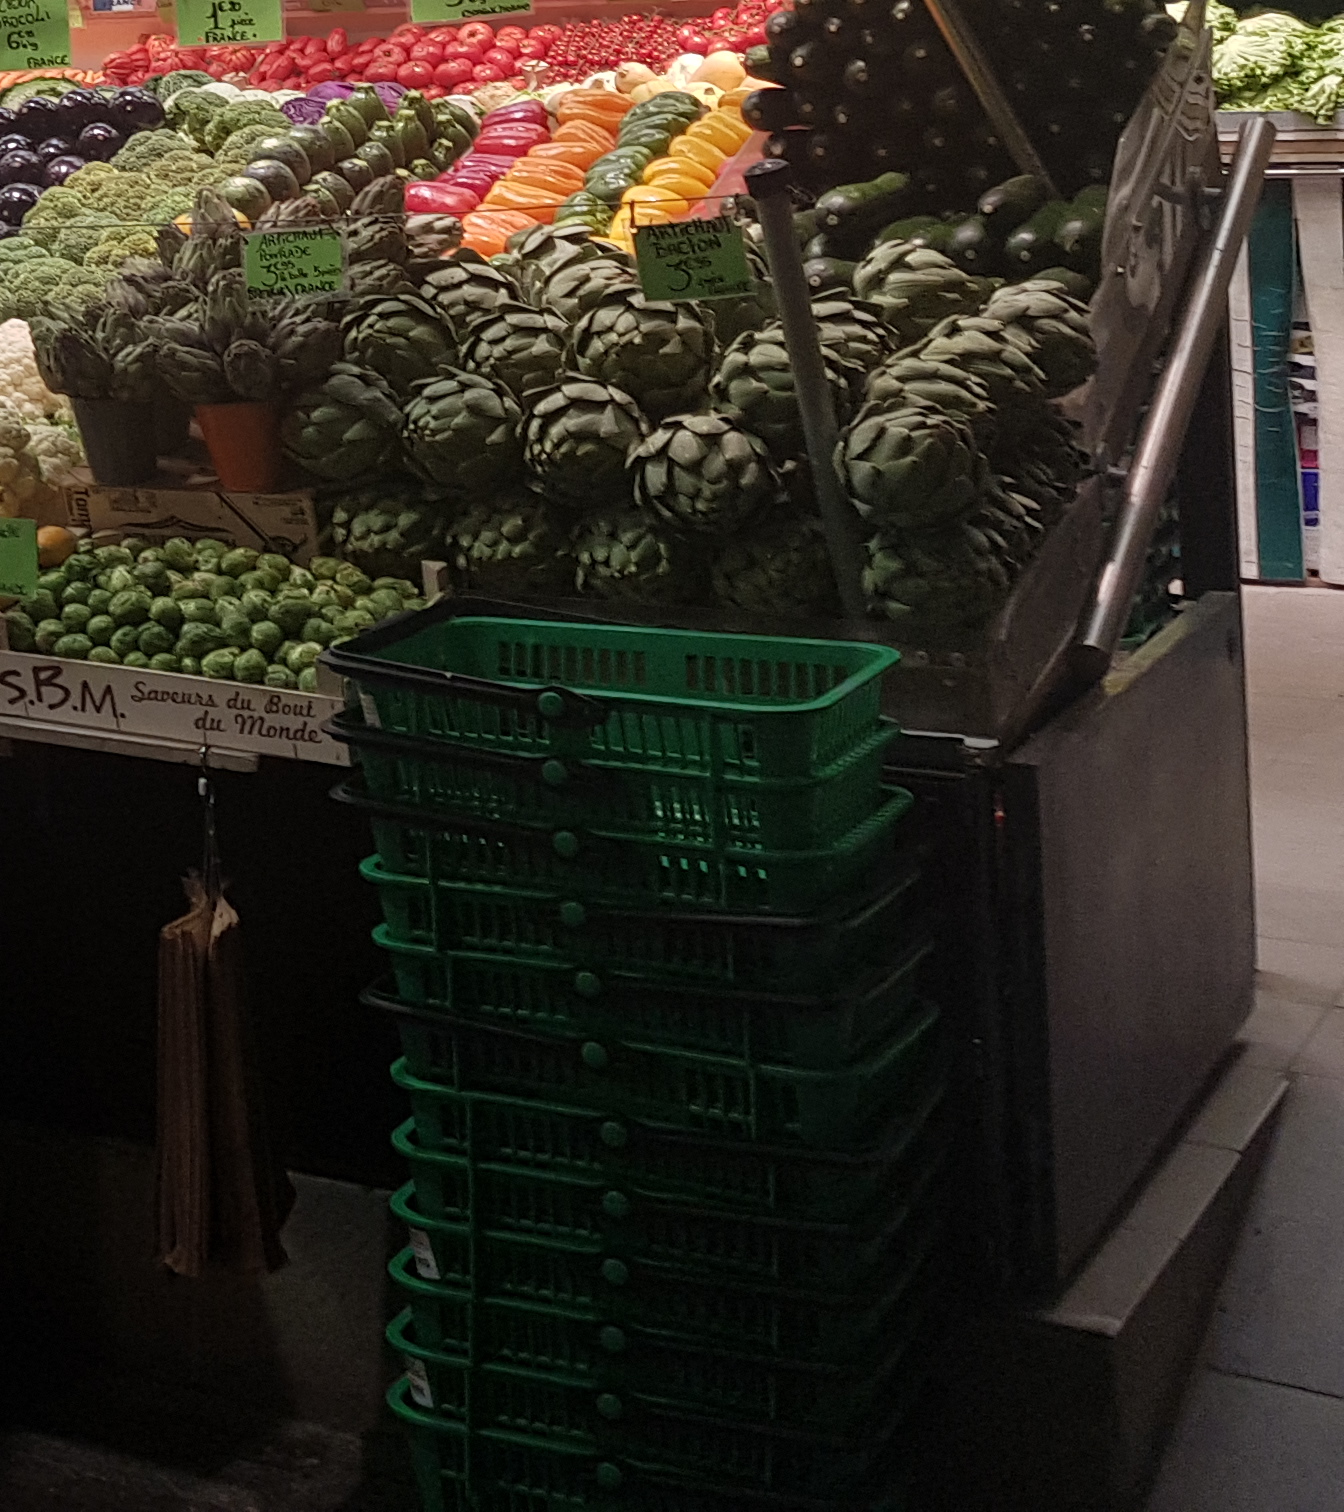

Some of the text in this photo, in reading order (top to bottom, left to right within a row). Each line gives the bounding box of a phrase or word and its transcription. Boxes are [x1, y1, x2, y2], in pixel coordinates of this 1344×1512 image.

[26, 55, 70, 69] FRANCE
[130, 681, 216, 708] Saveurs
[225, 691, 256, 711] du
[263, 694, 317, 718] Bout
[194, 712, 322, 743] du Monde
